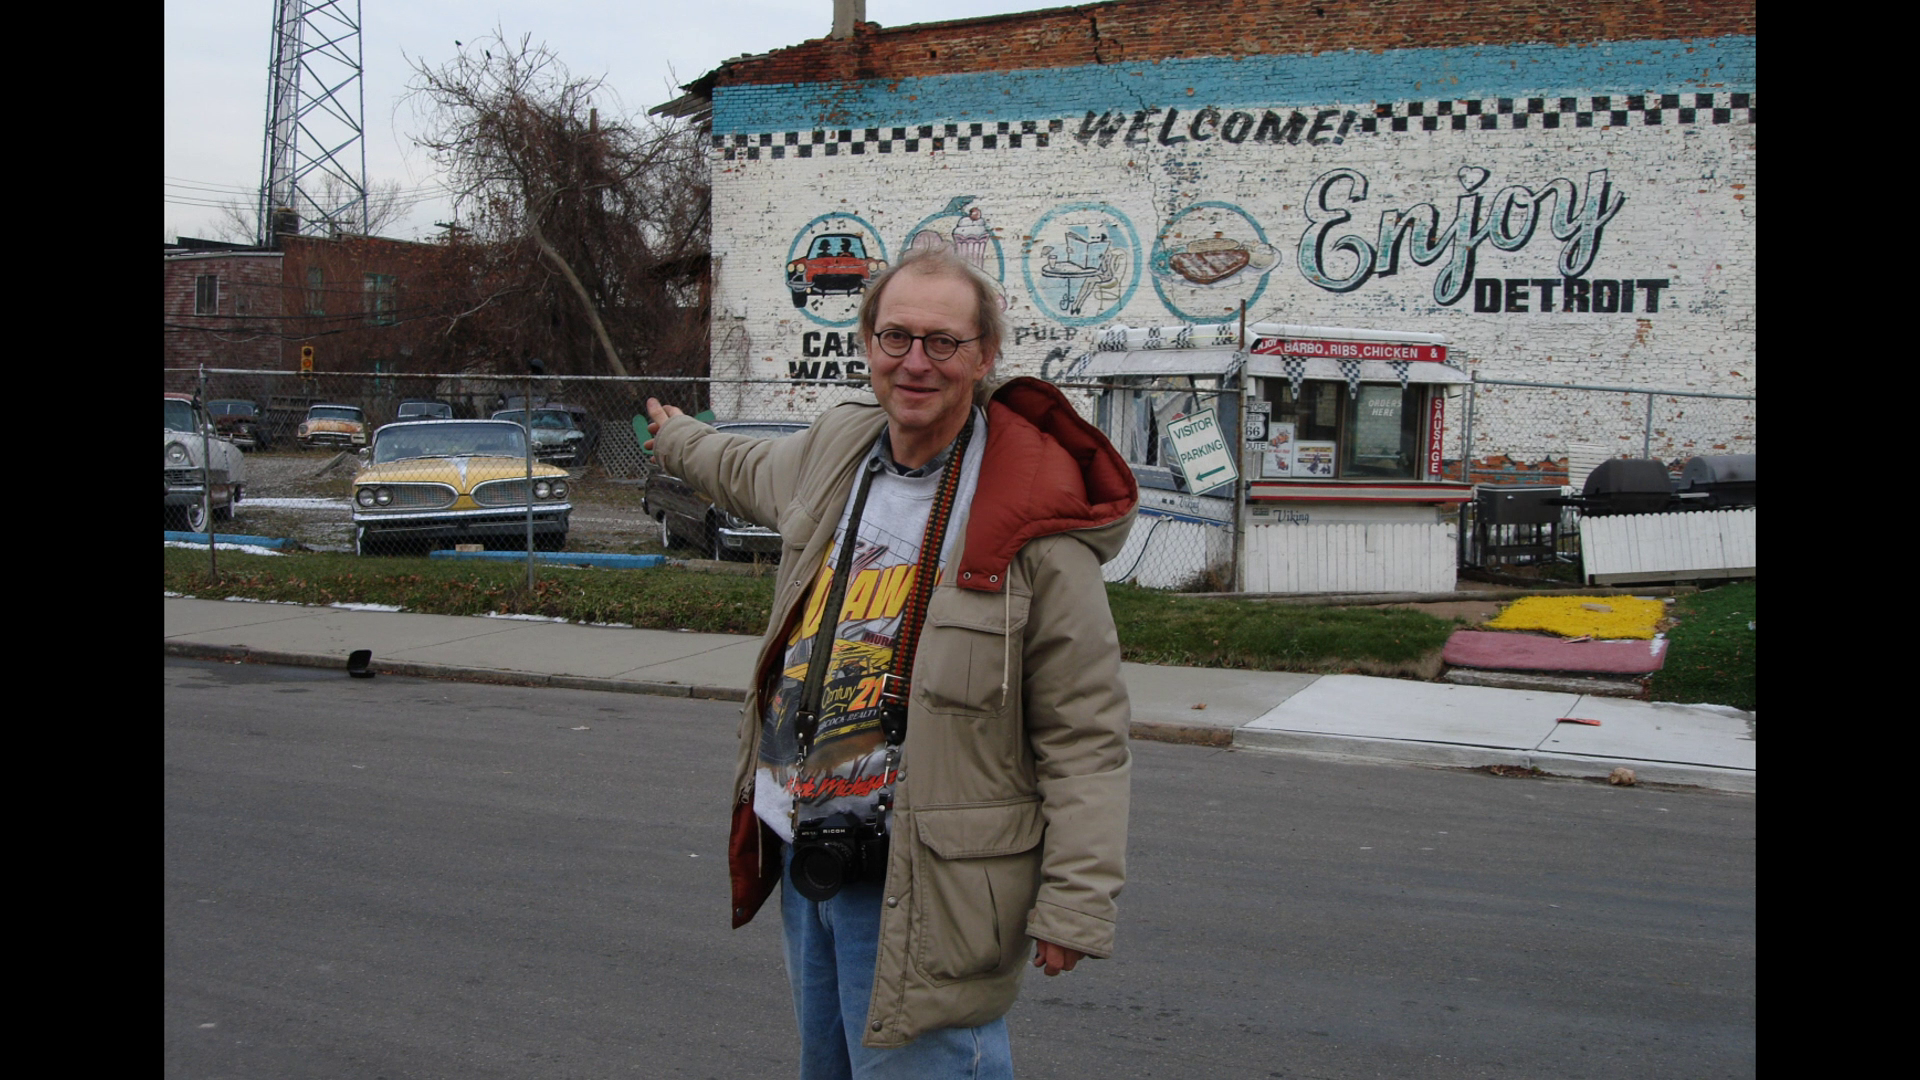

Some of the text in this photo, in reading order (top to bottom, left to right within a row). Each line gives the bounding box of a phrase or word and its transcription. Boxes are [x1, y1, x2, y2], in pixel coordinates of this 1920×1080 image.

[1076, 107, 1357, 148] WELCOME!
[1297, 165, 1626, 306] Enjoy
[1474, 277, 1669, 313] DETROIT
[1014, 325, 1077, 345] PULP
[1363, 346, 1419, 359] CHICKEN
[1430, 347, 1439, 359] &
[789, 360, 870, 388] WAS
[1371, 408, 1394, 417] HERE
[1173, 417, 1214, 439] VISITOR
[1246, 425, 1261, 438] 66
[1431, 398, 1443, 473] SAUSAGE
[1180, 439, 1223, 464] PARKING
[1276, 509, 1310, 526] Viking
[822, 676, 885, 712] Century 21
